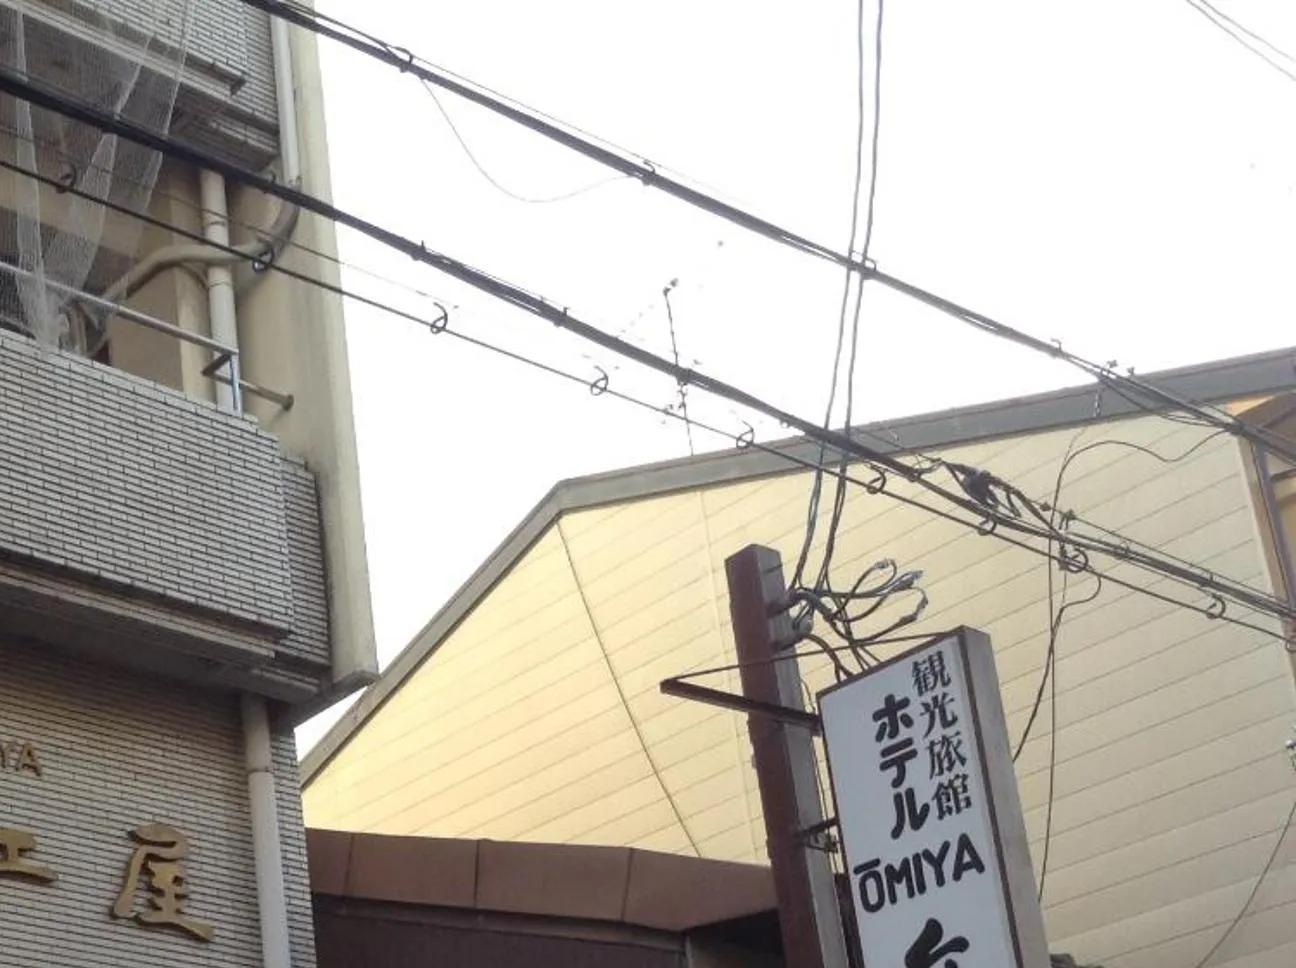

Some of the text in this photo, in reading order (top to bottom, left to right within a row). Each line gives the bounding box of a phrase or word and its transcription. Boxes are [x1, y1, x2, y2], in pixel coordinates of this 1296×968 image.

[872, 693, 930, 840] ホテル
[911, 650, 972, 821] 観光旅館
